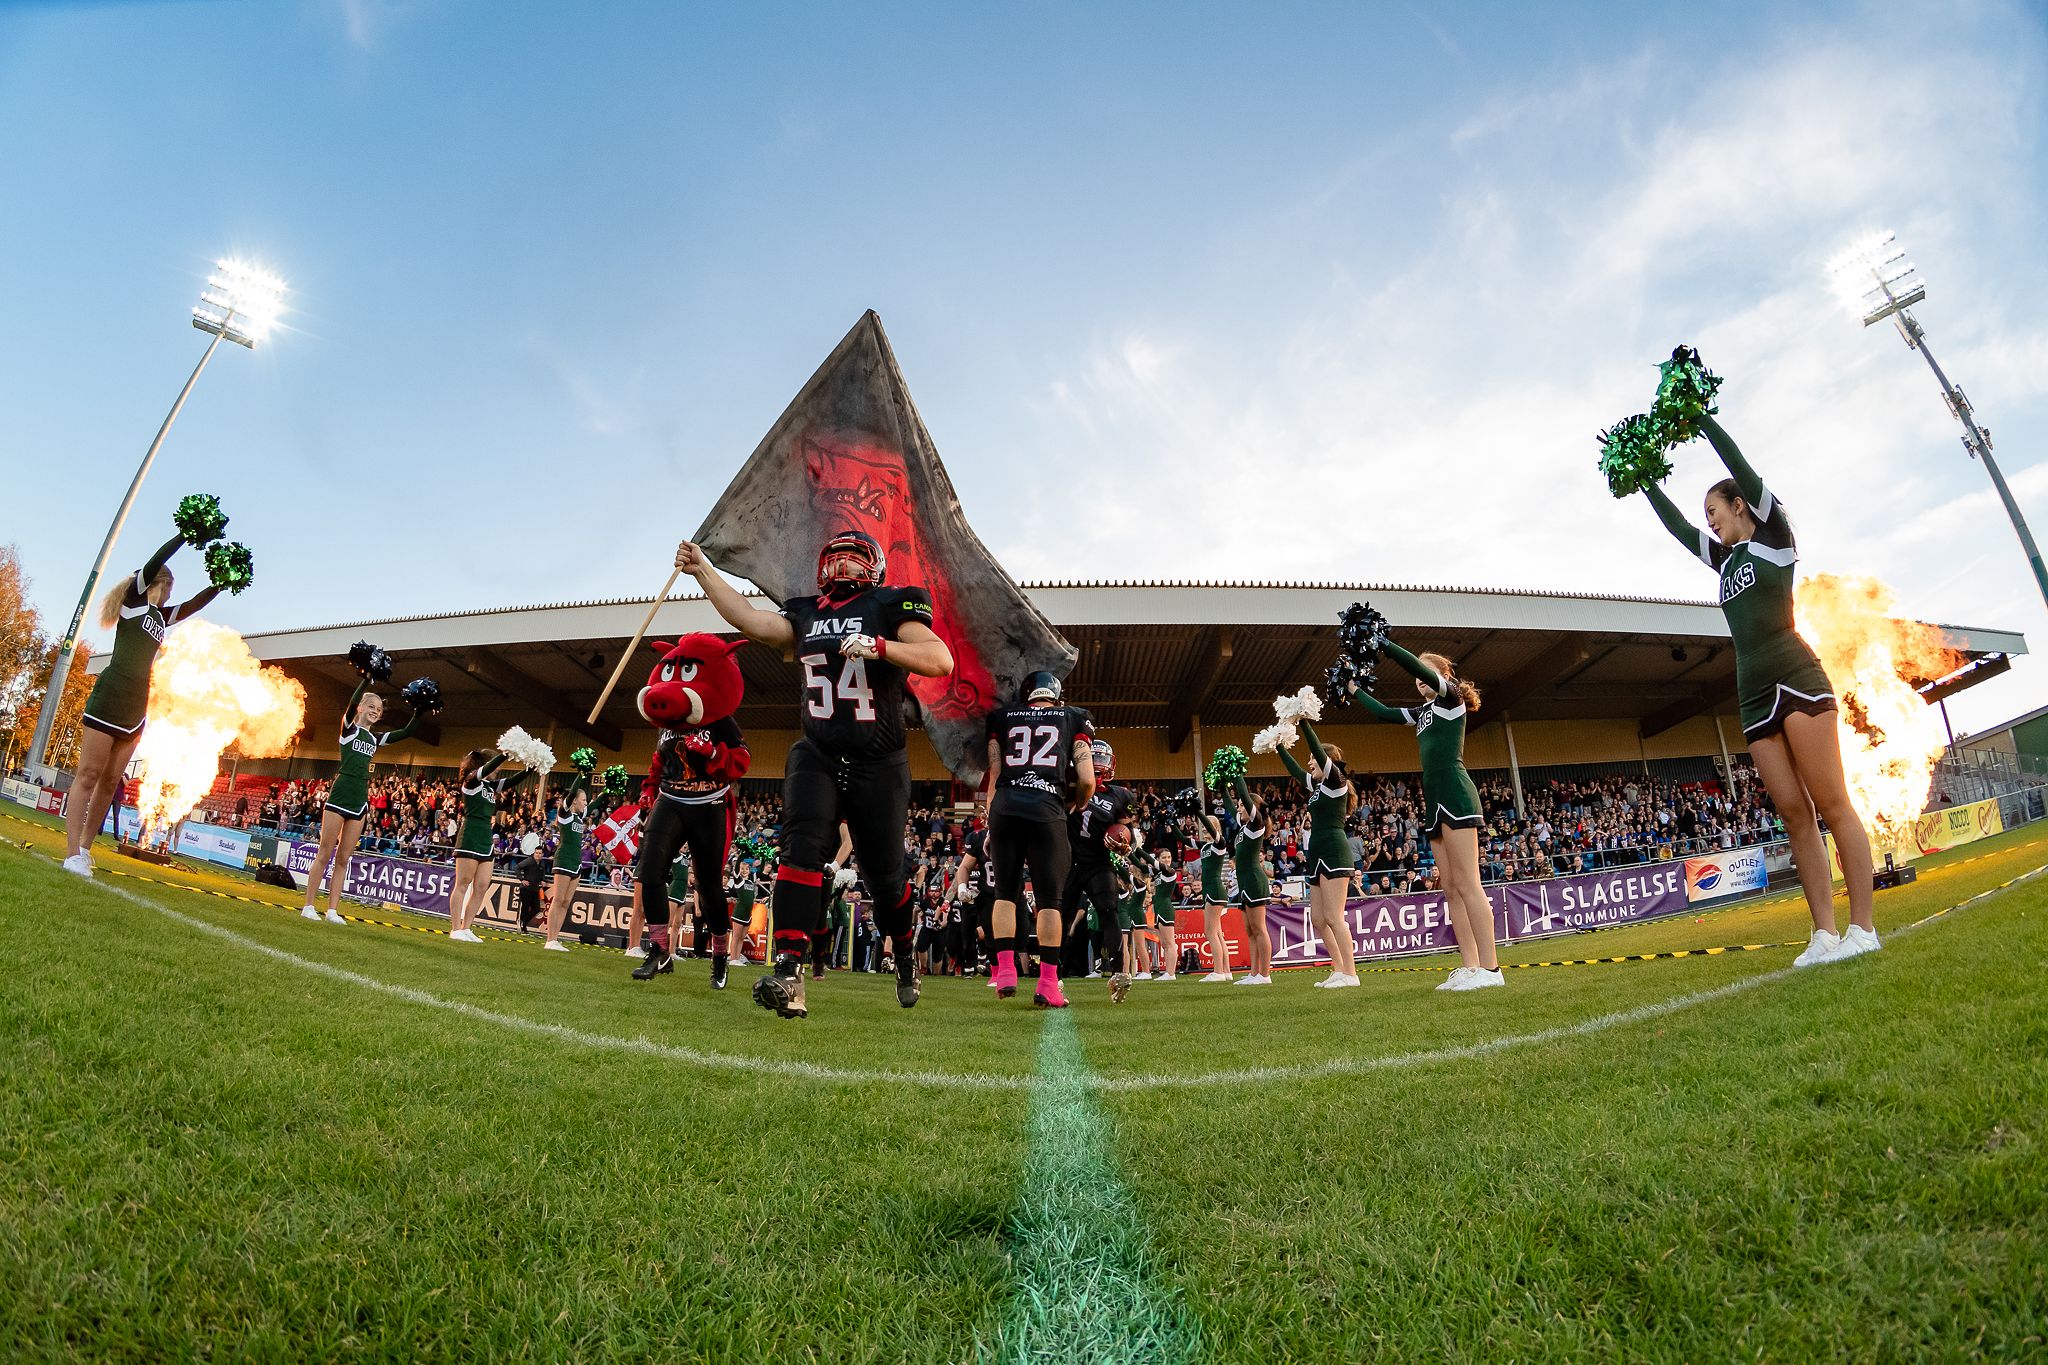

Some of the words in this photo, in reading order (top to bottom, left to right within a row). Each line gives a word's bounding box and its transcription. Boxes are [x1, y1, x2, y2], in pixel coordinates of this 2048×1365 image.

[1720, 562, 1756, 605] AKS
[805, 616, 863, 638] JKVS
[801, 653, 876, 722] 54
[1006, 710, 1065, 718] MUNKEBJERG
[1005, 725, 1059, 767] 32
[1080, 809, 1092, 837] 1
[357, 861, 449, 897] SLAGELSE
[1728, 858, 1760, 873] OUTLET
[356, 883, 408, 904] KOMMUNE
[476, 883, 518, 921] XL
[1562, 870, 1678, 912] SLAGELSE
[1564, 904, 1637, 927] KOMMUNE
